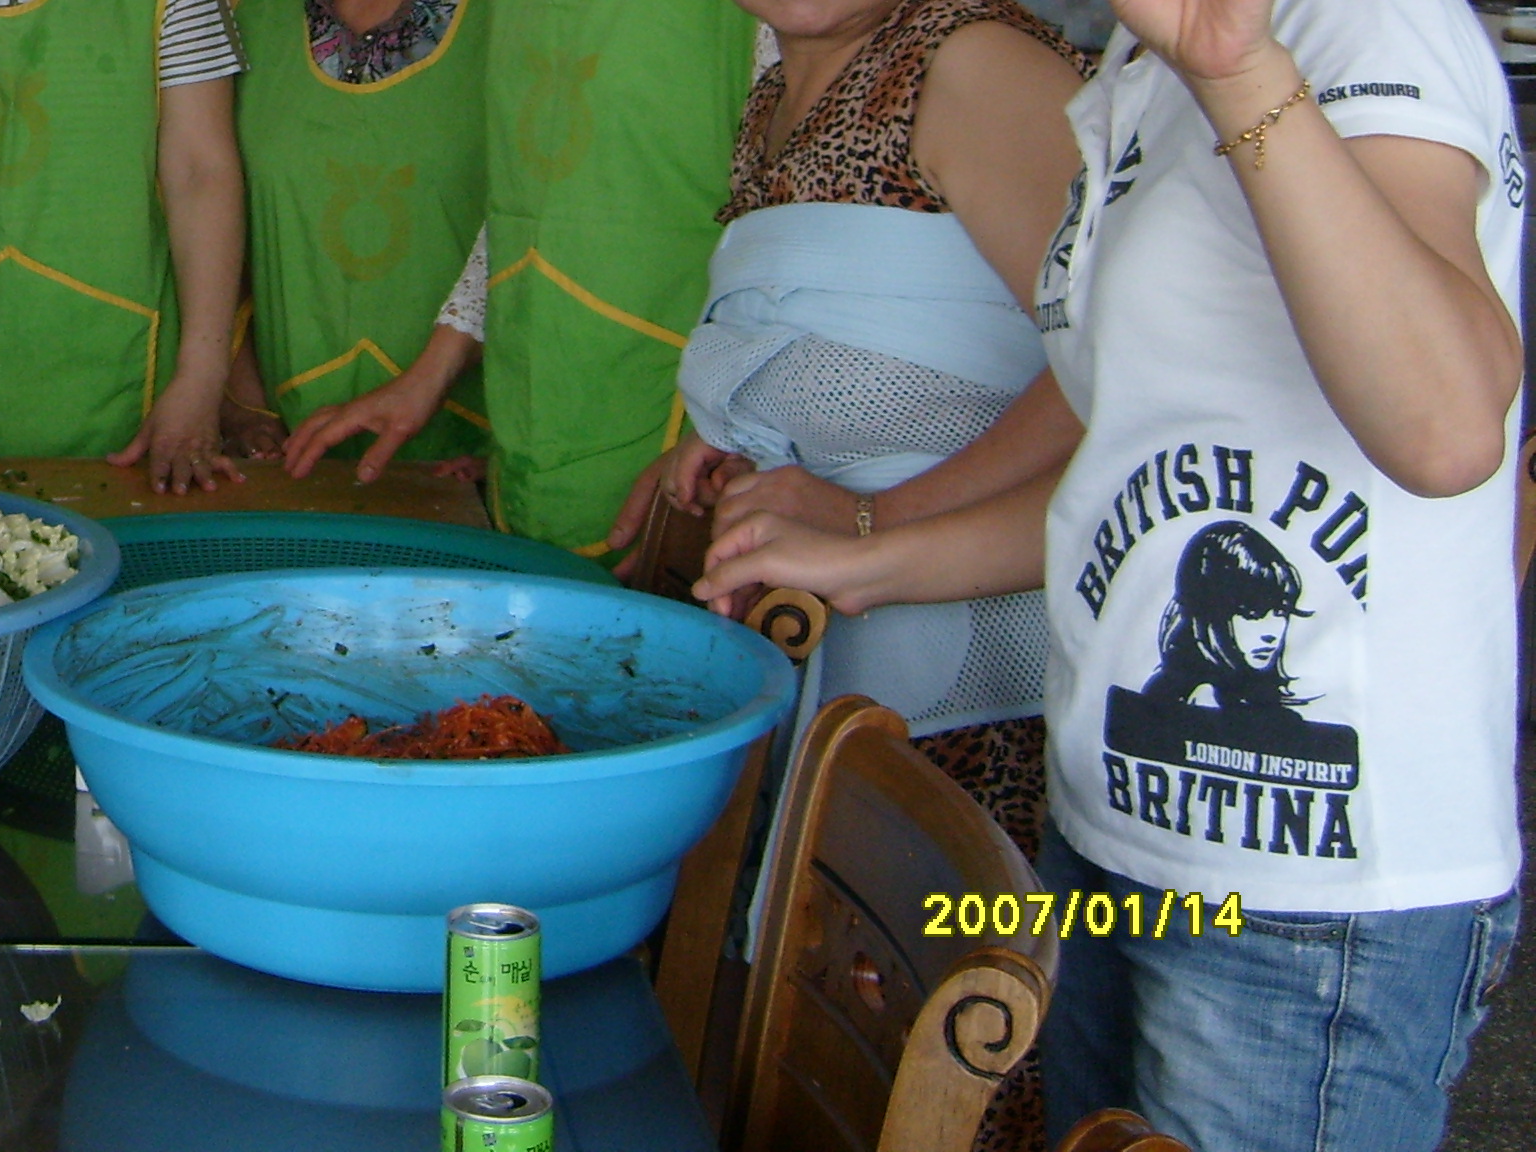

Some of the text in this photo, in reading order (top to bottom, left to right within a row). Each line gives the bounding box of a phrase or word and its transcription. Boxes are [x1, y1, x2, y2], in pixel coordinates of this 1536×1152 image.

[1318, 86, 1348, 106] ASK
[1074, 443, 1254, 622] BRITISH
[1184, 739, 1354, 784] LONDON INSPIRIT
[1101, 751, 1359, 860] BRITINA
[500, 957, 532, 984] 매실
